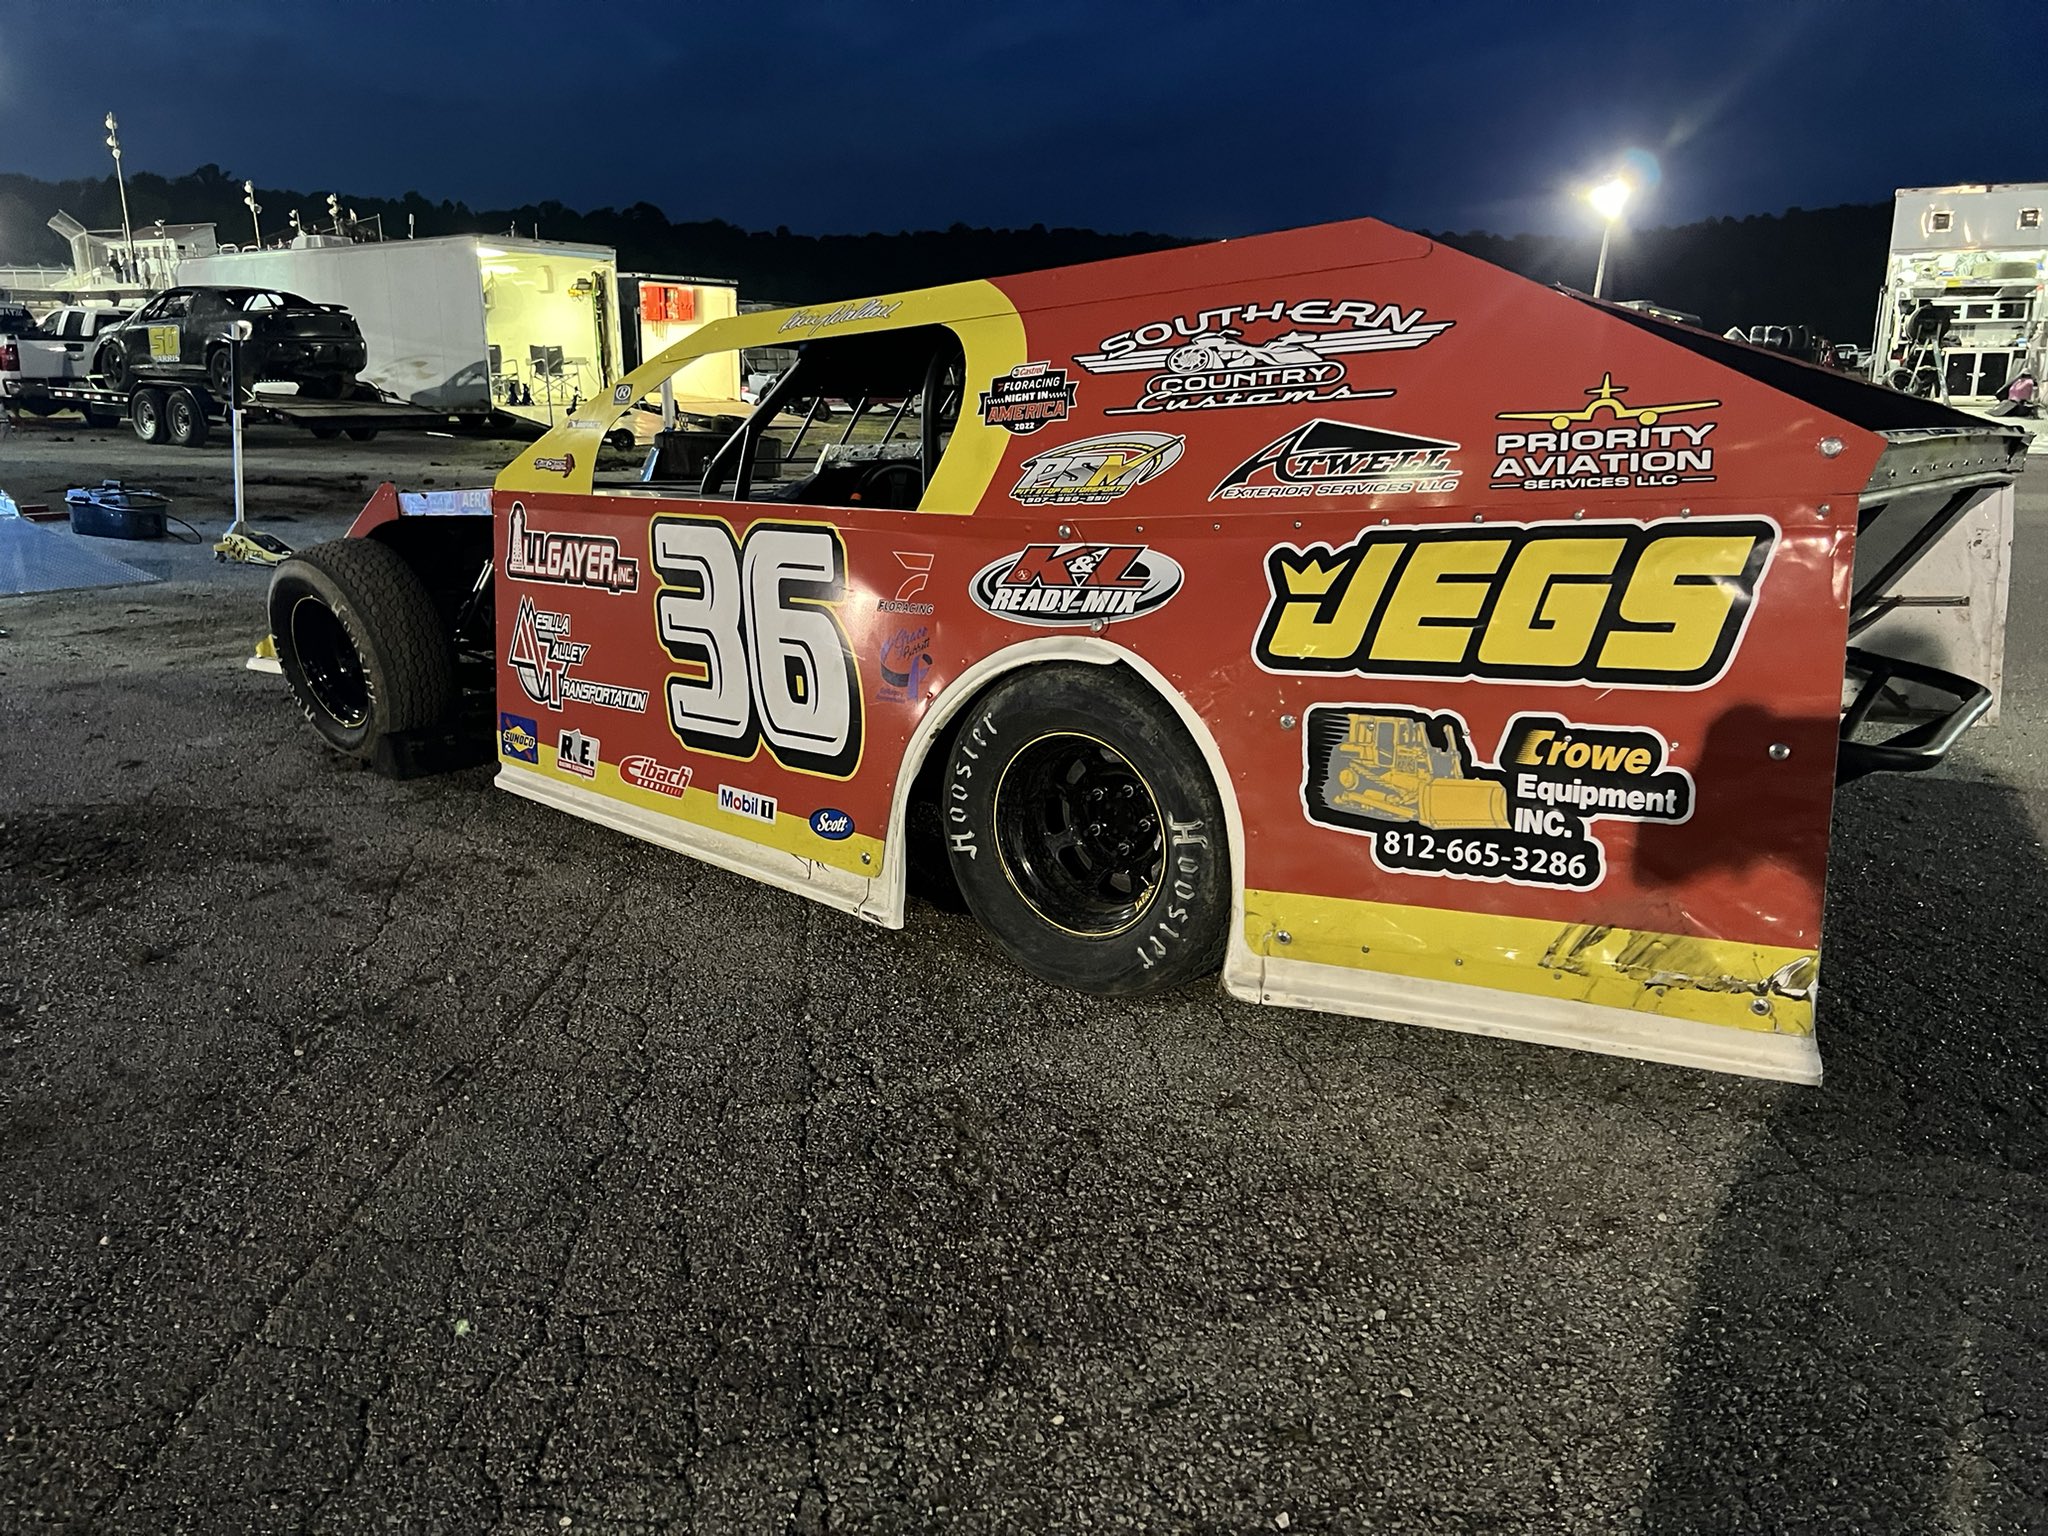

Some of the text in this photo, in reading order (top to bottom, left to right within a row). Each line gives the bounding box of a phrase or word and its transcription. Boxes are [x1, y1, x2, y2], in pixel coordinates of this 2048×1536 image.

[1100, 300, 1426, 359] SOUTHERN
[1003, 376, 1061, 392] FLORACING
[1019, 366, 1044, 377] Castrol
[1160, 365, 1333, 392] COUNTRY
[1004, 391, 1049, 403] NIGHT IN
[1137, 386, 1353, 413] Customs
[986, 400, 1065, 423] AMERICA
[1014, 422, 1035, 431] 2022
[1497, 424, 1716, 455] PRIORITY
[1017, 453, 1142, 488] PSM
[1209, 421, 1450, 497] ATWELL
[1492, 450, 1713, 478] AVIATION
[1013, 487, 1036, 496] PITT
[1036, 487, 1060, 495] STOP
[1060, 485, 1128, 495] MOTORSPORTS
[1224, 480, 1458, 498] EXTERIOR SERVICES LLC
[1523, 475, 1678, 490] SERVICES LLC
[617, 565, 635, 584] INC.
[876, 600, 935, 615] FLORACING
[990, 588, 1142, 614] READY-MIX
[1268, 536, 1757, 672] JEGS
[652, 519, 857, 764] 36
[503, 730, 535, 748] SUNOCO
[1515, 729, 1652, 775] Crowe
[620, 756, 692, 789] Eibach
[721, 788, 773, 818] Mobil 1
[1516, 773, 1678, 815] Equipment
[816, 812, 848, 832] Scott
[1514, 807, 1573, 838] INC.
[1383, 830, 1588, 880] 812-665-3286
